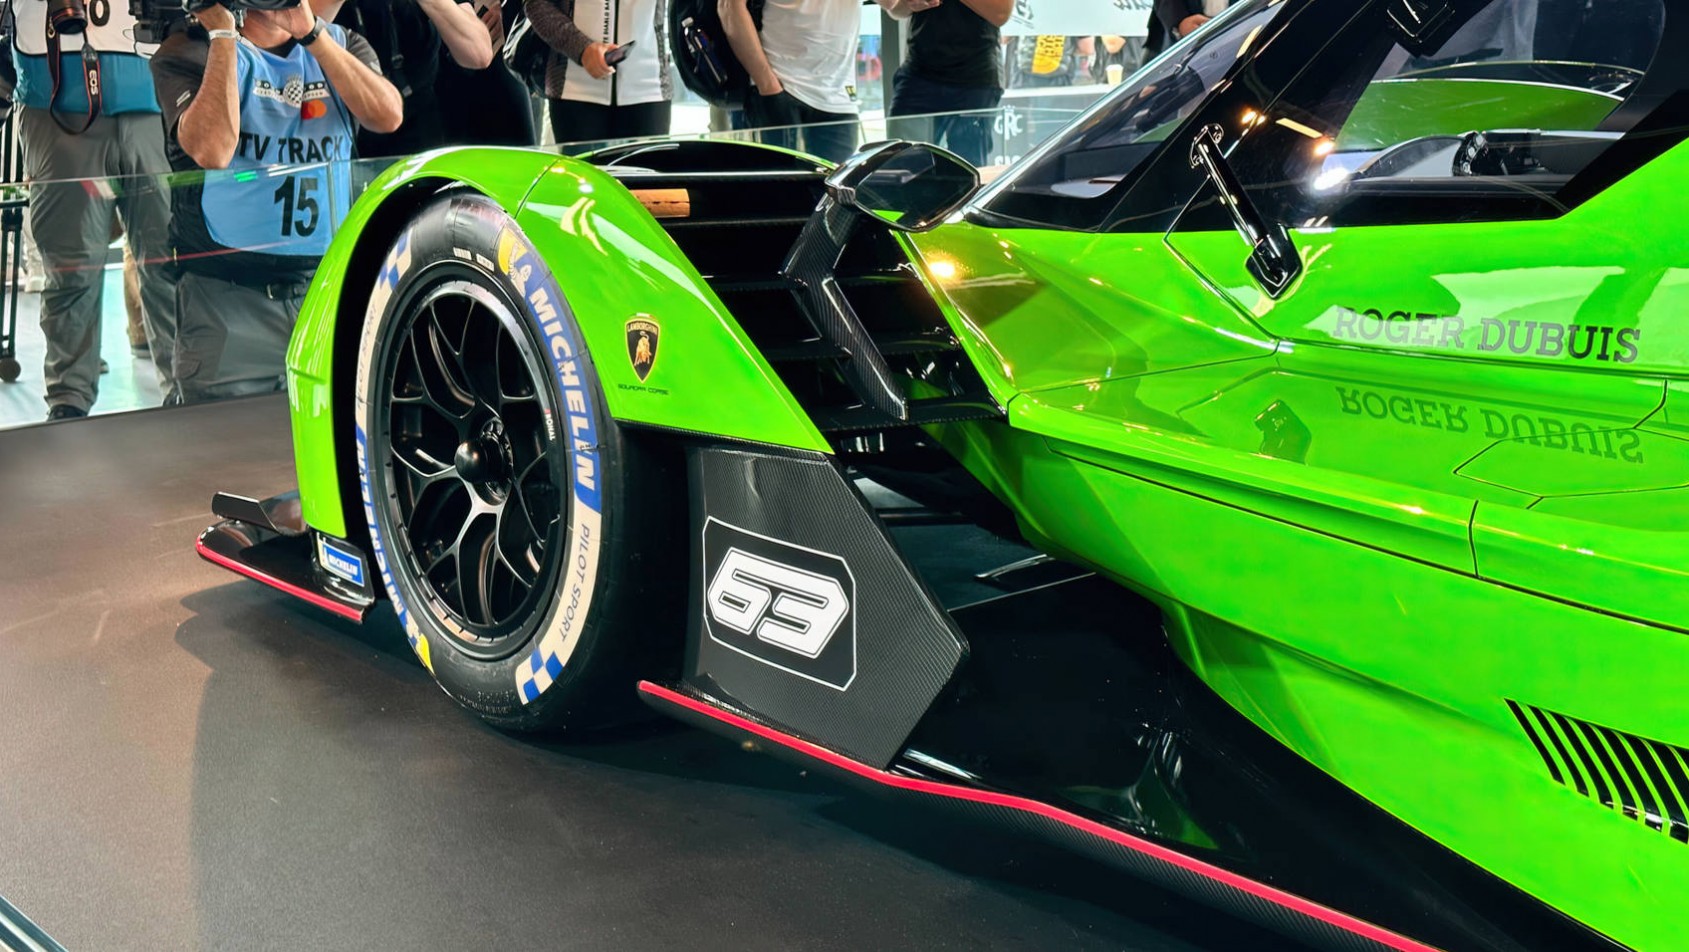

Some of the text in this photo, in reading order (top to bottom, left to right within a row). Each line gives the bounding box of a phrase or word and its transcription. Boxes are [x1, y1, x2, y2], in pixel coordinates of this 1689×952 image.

[89, 70, 98, 95] EOS
[239, 132, 343, 163] TV TRACK
[274, 175, 319, 237] 15
[1333, 306, 1641, 363] ROGER DUBUIS
[528, 287, 596, 492] MICHELIN
[558, 523, 590, 642] PILOT SPORT
[708, 547, 850, 659] 63
